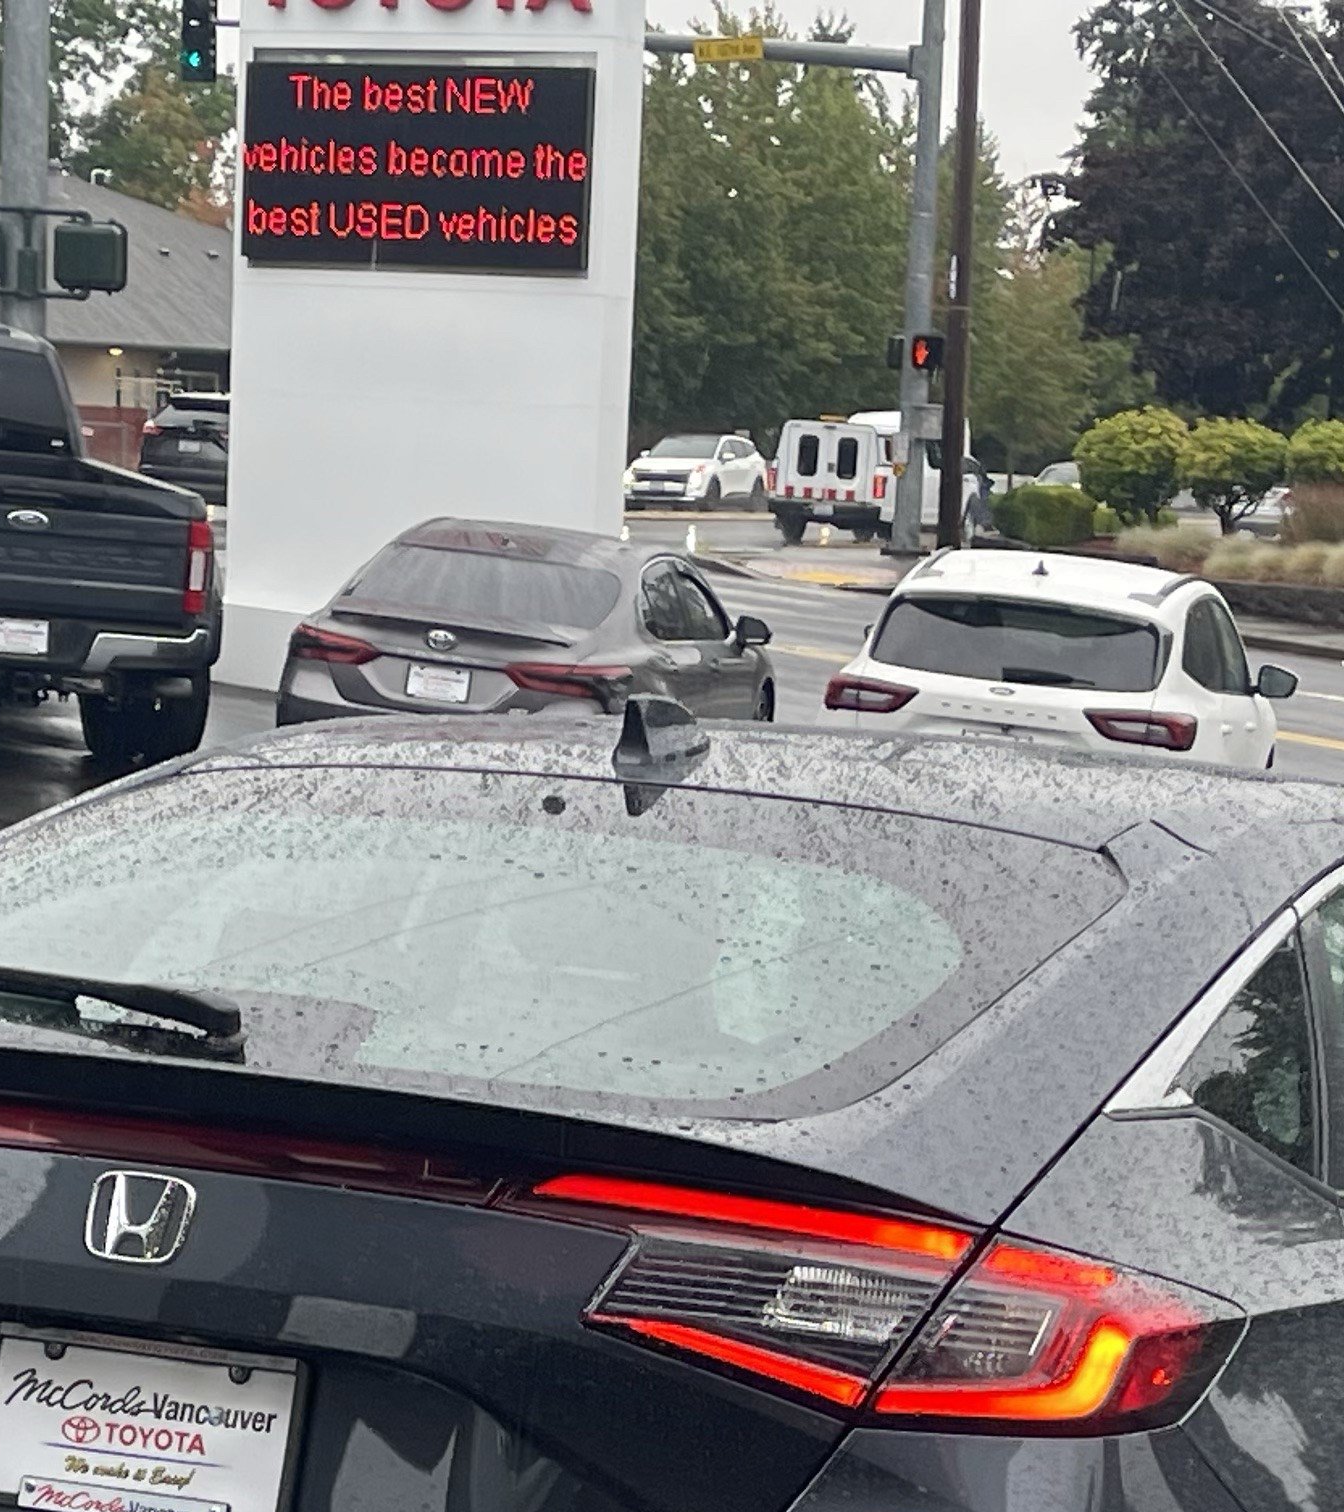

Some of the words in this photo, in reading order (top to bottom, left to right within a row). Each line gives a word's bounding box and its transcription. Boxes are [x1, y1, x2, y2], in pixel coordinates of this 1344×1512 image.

[288, 73, 353, 112] The
[362, 75, 437, 115] best
[445, 77, 536, 116] NEW
[244, 137, 378, 176] vehicles
[387, 139, 526, 181] become
[533, 142, 588, 183] the
[247, 198, 321, 238] best
[328, 202, 430, 241] USED
[438, 205, 579, 247] vehicles
[153, 1391, 278, 1433] Vancouver
[105, 1421, 206, 1456] TOYOTA
